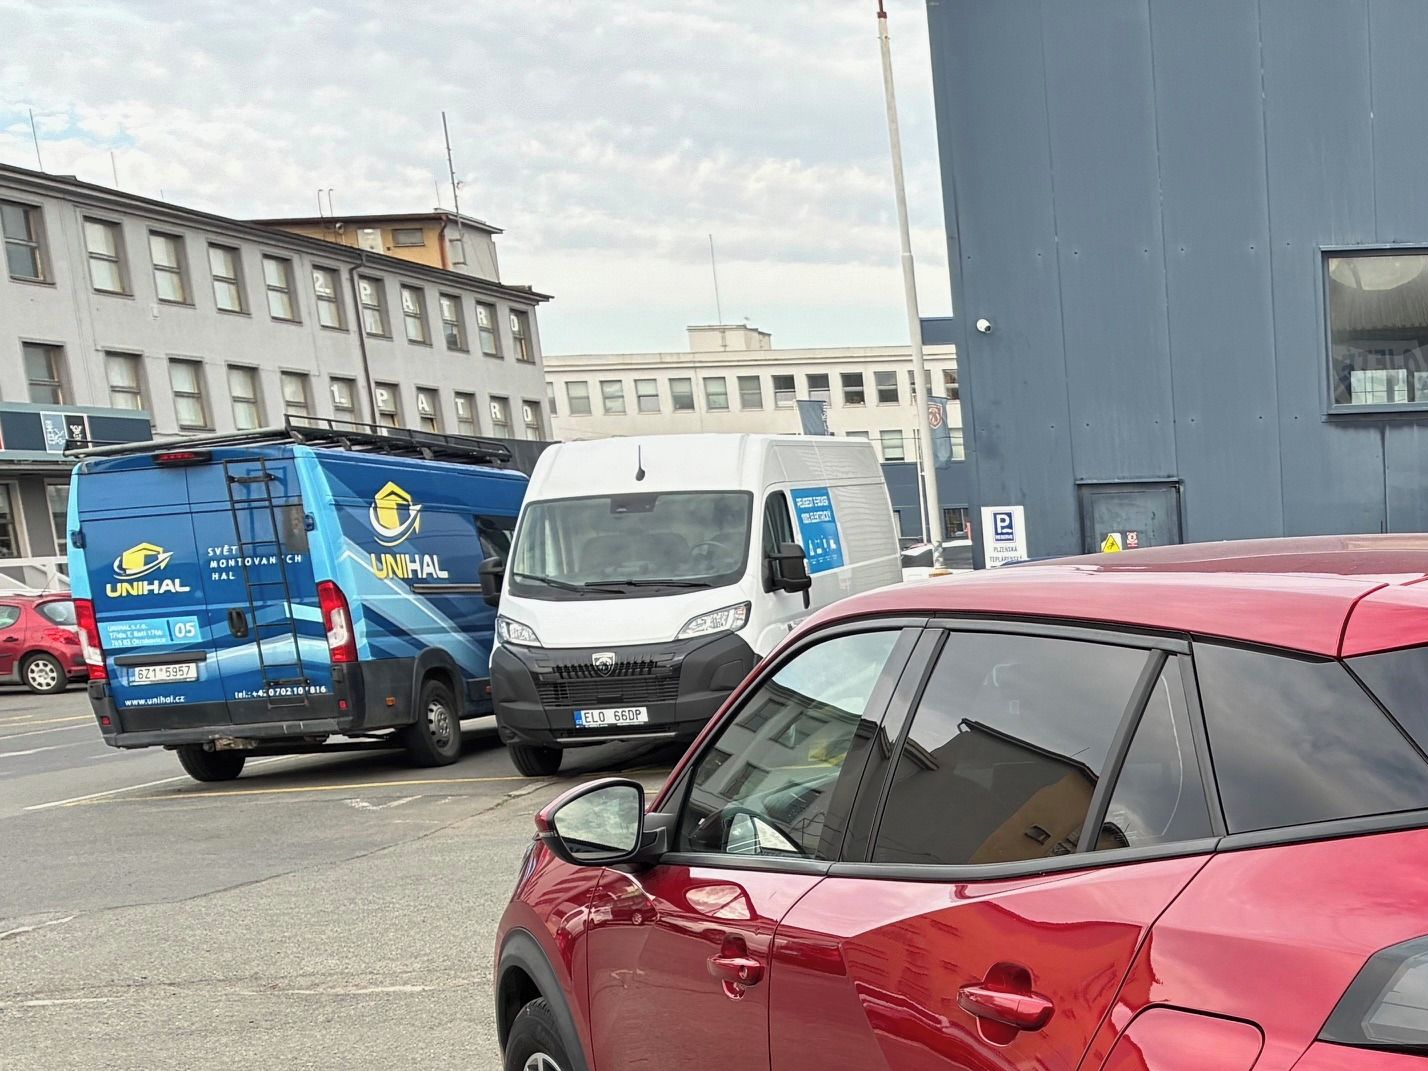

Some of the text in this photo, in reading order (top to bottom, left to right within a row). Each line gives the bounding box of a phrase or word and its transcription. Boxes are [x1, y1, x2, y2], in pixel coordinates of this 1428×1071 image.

[361, 284, 519, 331] PATRO
[376, 389, 531, 422] PATRO
[208, 545, 238, 556] SVĚT
[210, 554, 302, 568] MONTOVANCH
[370, 553, 449, 579] UNIHAL
[212, 572, 236, 580] HAL
[106, 579, 191, 597] UNIHAL
[174, 622, 196, 638] 05
[138, 666, 191, 679] 6Z1 5957
[124, 695, 185, 706] www.unihal.cz
[614, 709, 641, 721] 66DP
